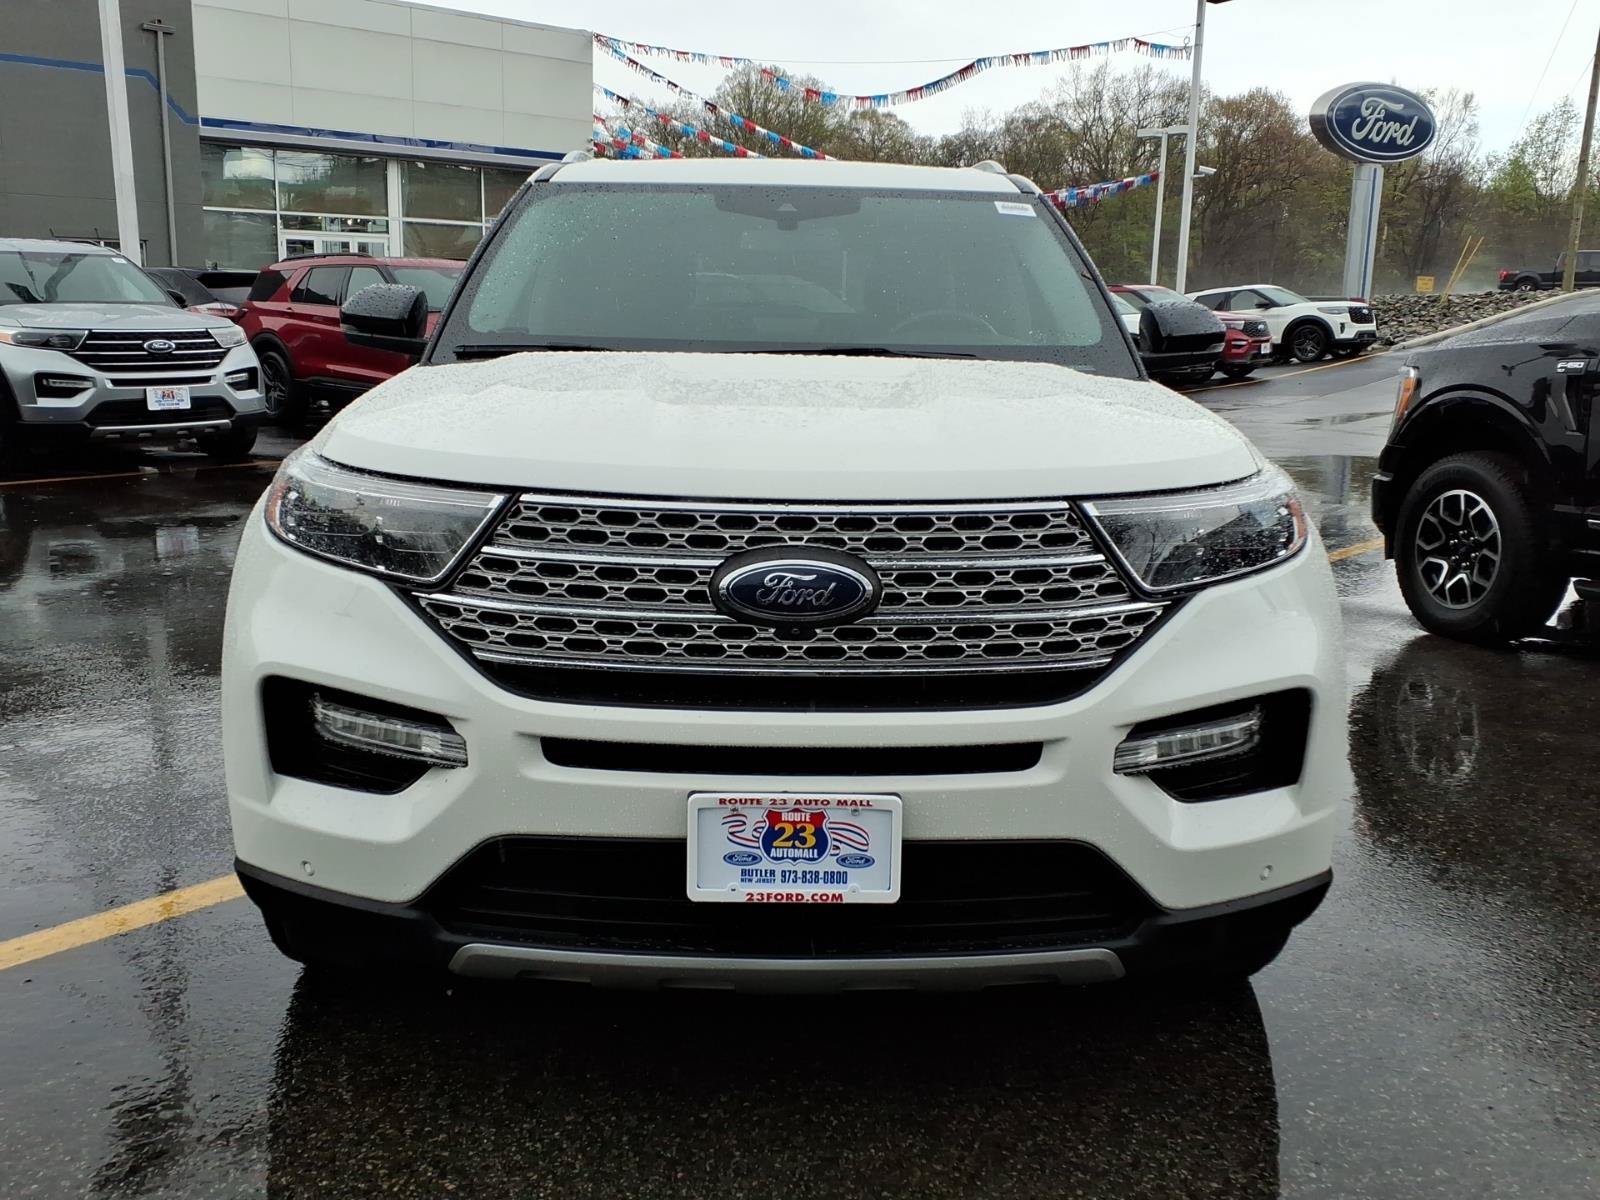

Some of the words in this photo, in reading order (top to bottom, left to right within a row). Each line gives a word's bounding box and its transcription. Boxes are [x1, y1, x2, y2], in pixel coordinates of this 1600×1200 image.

[1351, 97, 1418, 146] Ford
[756, 572, 837, 606] Ford
[719, 798, 763, 806] ROUTE
[769, 798, 789, 806] 23
[793, 798, 831, 807] AUTO
[836, 799, 873, 807] MALL
[781, 812, 811, 822] ROUTE
[773, 822, 817, 849] 23
[731, 854, 754, 863] Ford
[769, 848, 819, 859] AUTOMALL
[844, 856, 866, 865] Ford
[740, 869, 776, 878] BUTLER
[780, 870, 848, 885] 973-838-0800
[745, 892, 844, 903] 23FORD.COM
